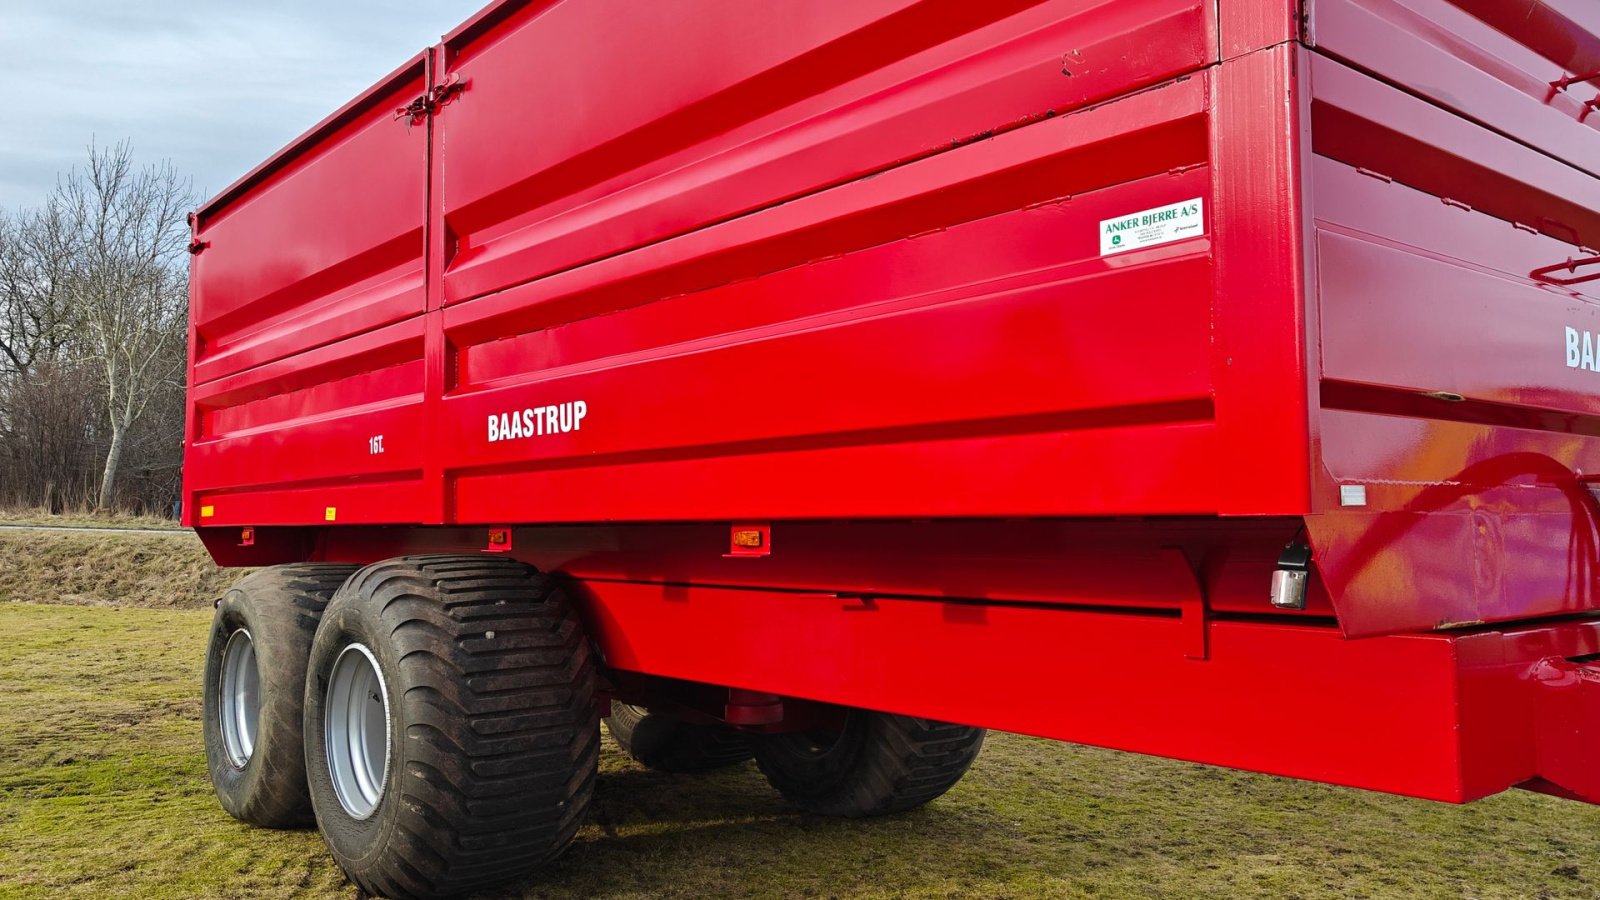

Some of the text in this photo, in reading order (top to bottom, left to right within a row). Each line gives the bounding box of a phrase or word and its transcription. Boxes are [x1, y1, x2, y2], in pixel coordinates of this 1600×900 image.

[1105, 217, 1139, 234] ANKER
[1142, 208, 1178, 226] BJERRE
[1181, 204, 1198, 217] A/S
[488, 400, 587, 442] BAASTRUP
